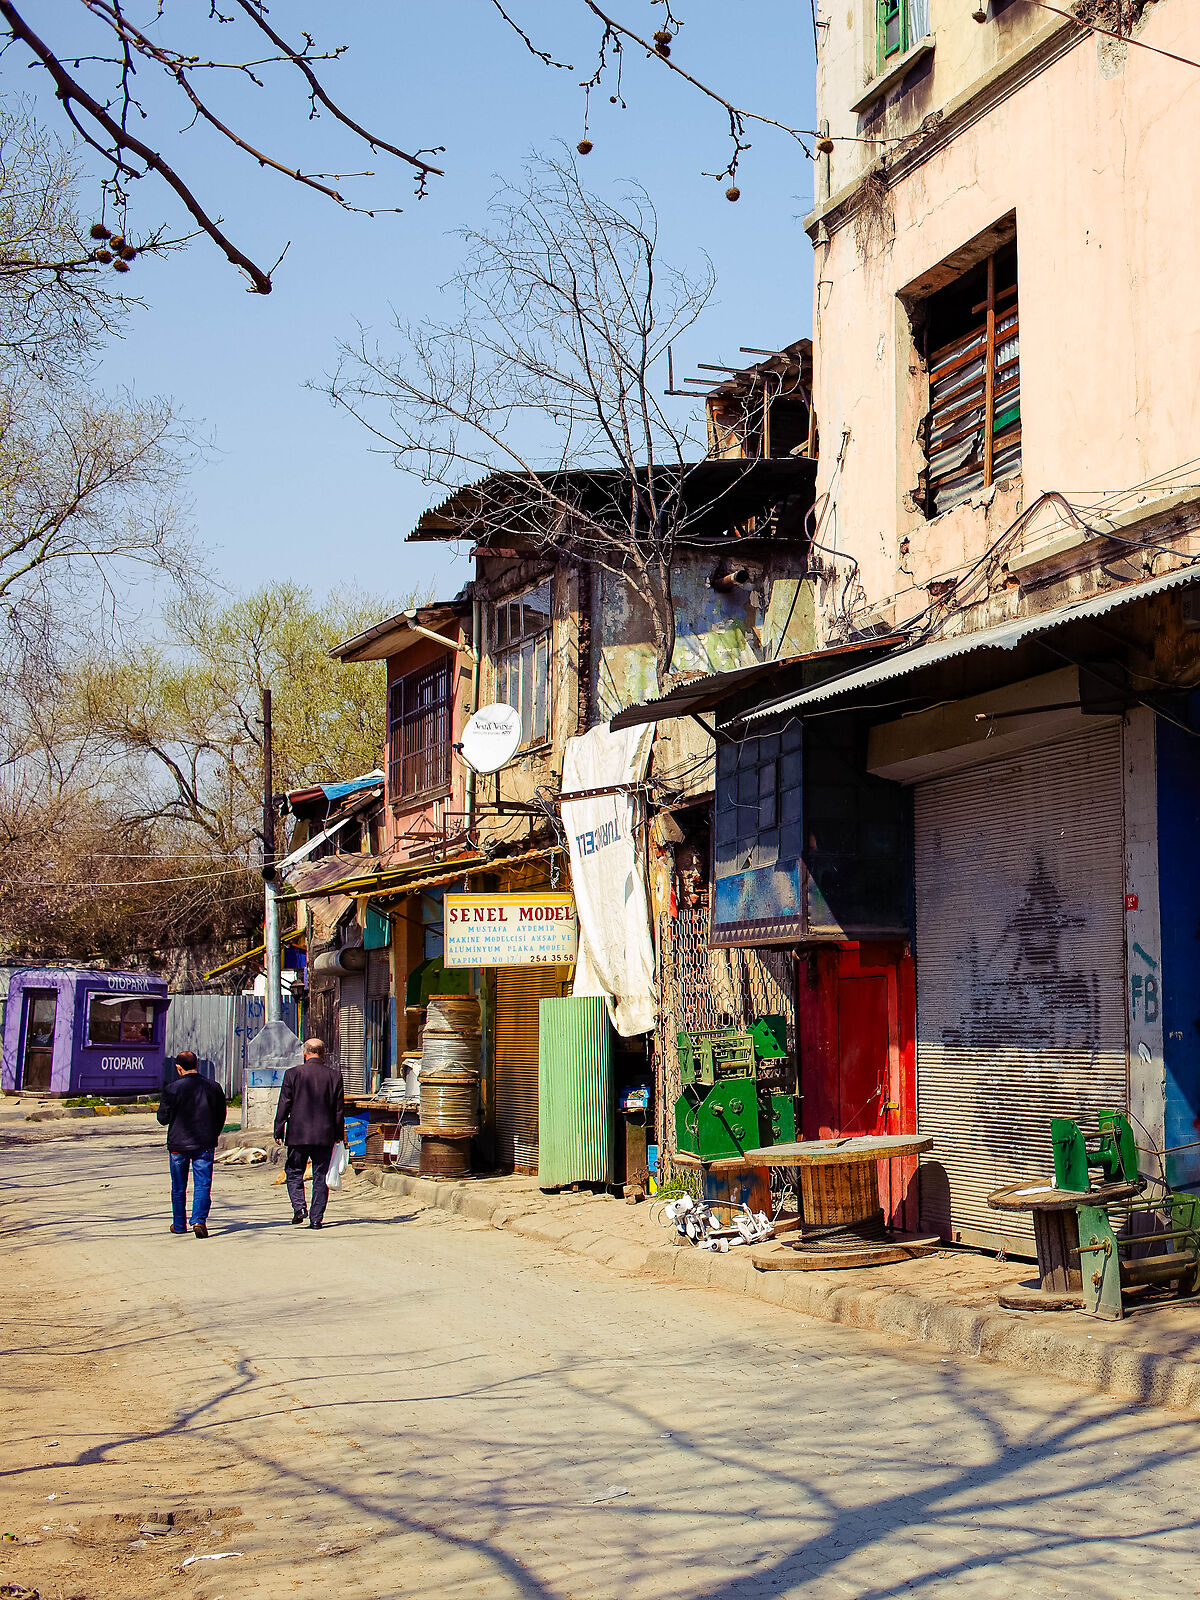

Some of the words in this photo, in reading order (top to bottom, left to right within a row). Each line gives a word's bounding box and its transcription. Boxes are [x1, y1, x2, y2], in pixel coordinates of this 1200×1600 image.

[449, 907, 509, 924] ŞENEL
[518, 906, 574, 921] MODEL
[530, 954, 547, 962] 254
[108, 976, 149, 991] OTOPARK
[1131, 973, 1158, 1023] FB
[101, 1056, 145, 1070] OTOPARK
